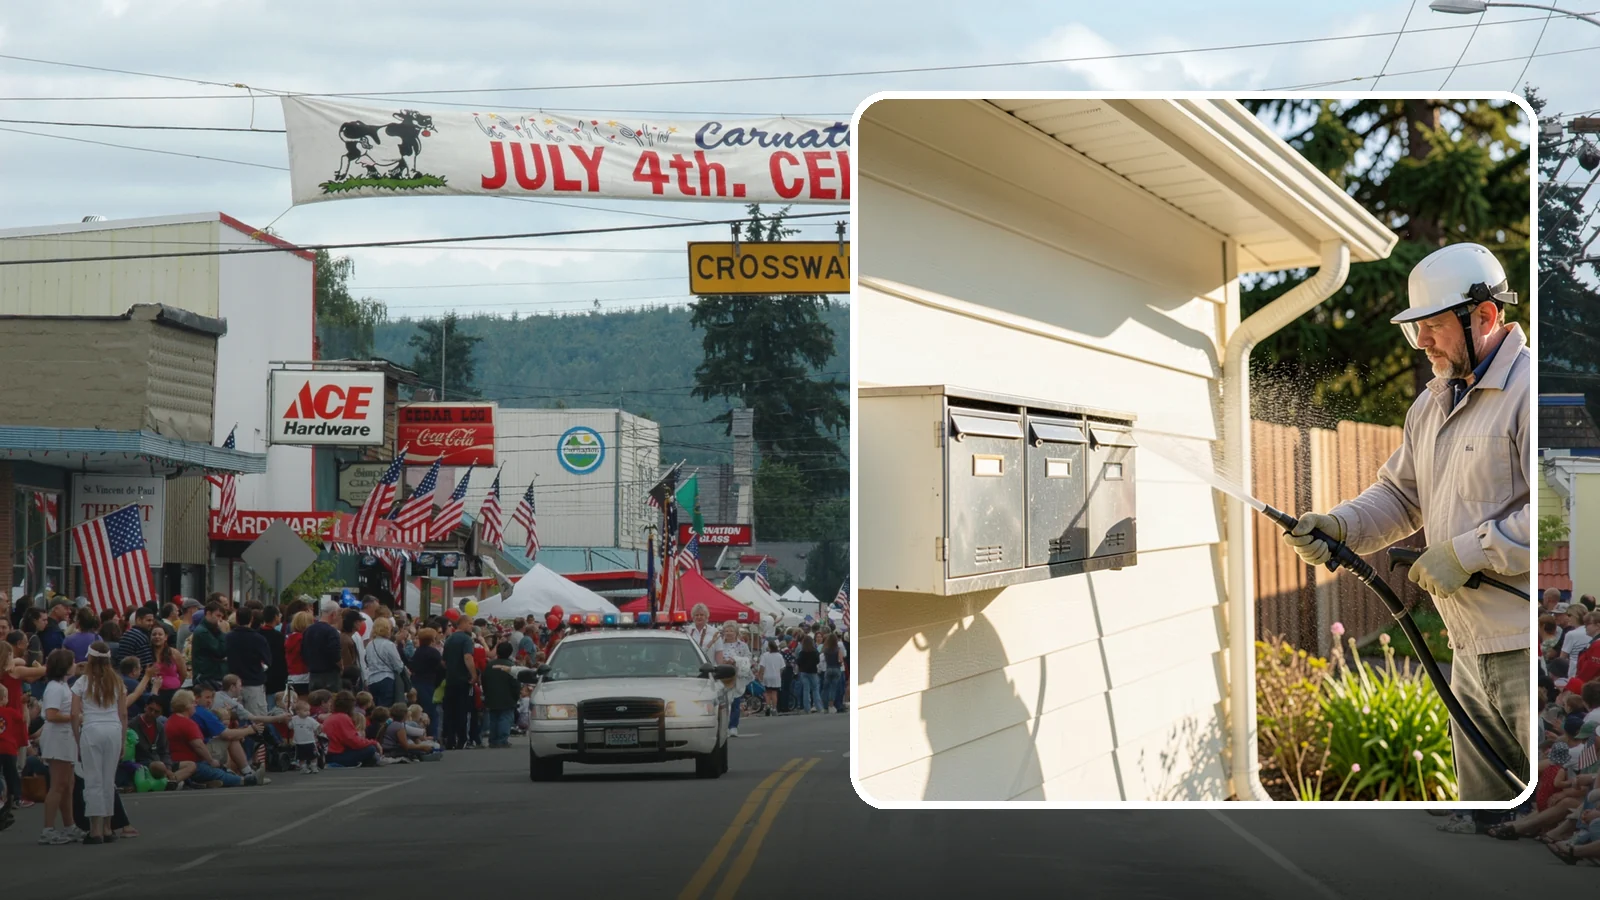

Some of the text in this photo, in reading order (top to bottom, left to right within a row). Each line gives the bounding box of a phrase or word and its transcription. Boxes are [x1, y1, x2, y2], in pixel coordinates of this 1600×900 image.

[481, 141, 605, 192] JULY
[632, 150, 746, 198] 4th.
[697, 254, 850, 280] CROSSWA
[283, 380, 373, 420] ACE
[406, 409, 452, 422] CEDAR
[283, 421, 371, 437] Hardware
[416, 428, 477, 447] Coca-Cola
[96, 485, 124, 495] Vincent
[126, 486, 136, 495] de
[137, 486, 155, 495] Paul
[688, 526, 741, 535] CRNATION
[699, 535, 730, 543] GLASS
